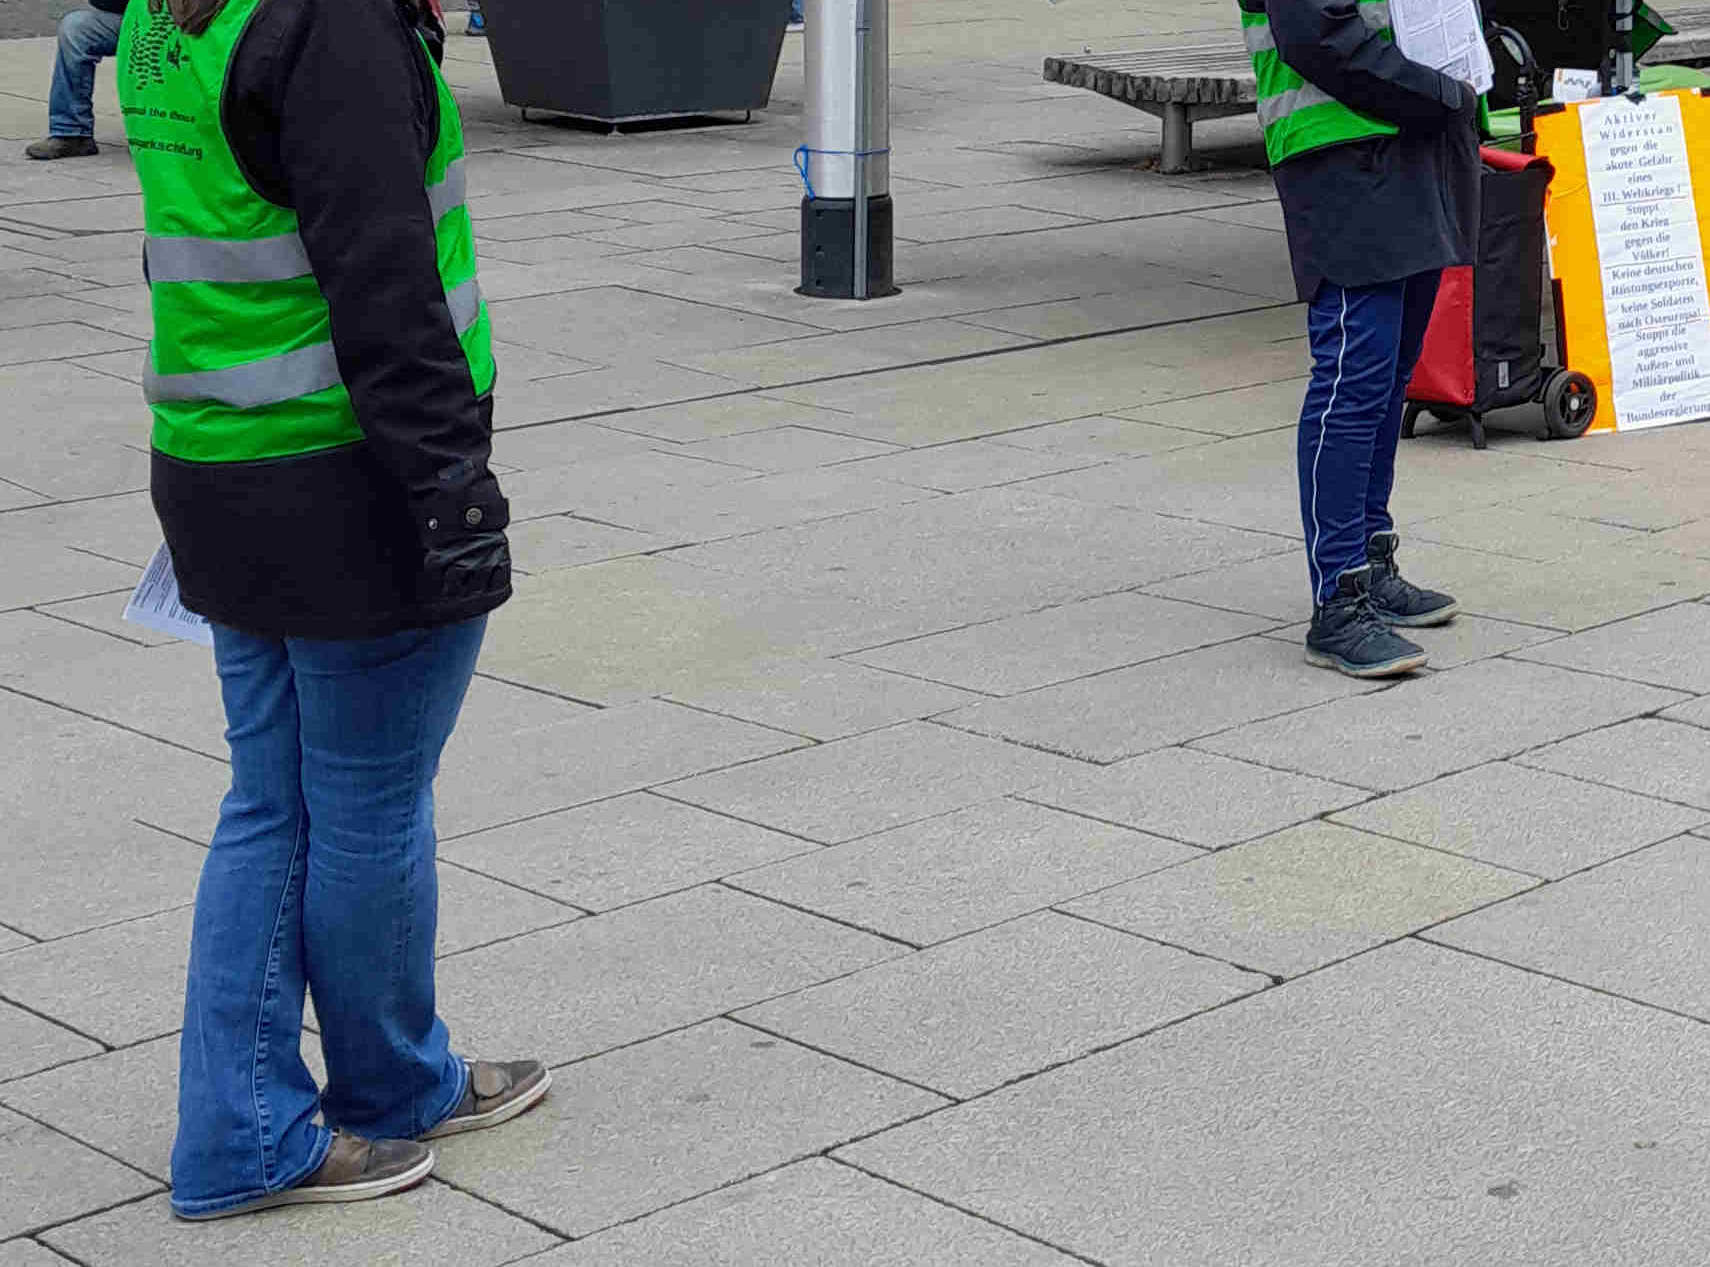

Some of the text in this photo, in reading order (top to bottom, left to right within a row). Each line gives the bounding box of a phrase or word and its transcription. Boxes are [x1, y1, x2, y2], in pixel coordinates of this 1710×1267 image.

[1604, 112, 1656, 125] Aktiver
[1609, 140, 1658, 157] gegen die
[1605, 154, 1672, 171] akute Gefahr
[1627, 174, 1653, 184] eines
[1622, 186, 1675, 200] Weltkriegs
[1626, 203, 1658, 216] Stoppt
[1620, 218, 1670, 231] den Krieg
[1624, 232, 1671, 249] gegen die
[1632, 248, 1670, 261] Völker!
[1611, 262, 1694, 280] Keine deutschen
[1621, 295, 1695, 313] keine Soldaten
[1618, 317, 1642, 329] nach
[1635, 325, 1687, 343] Stoppt die
[1675, 355, 1695, 367] und
[1660, 390, 1678, 402] der
